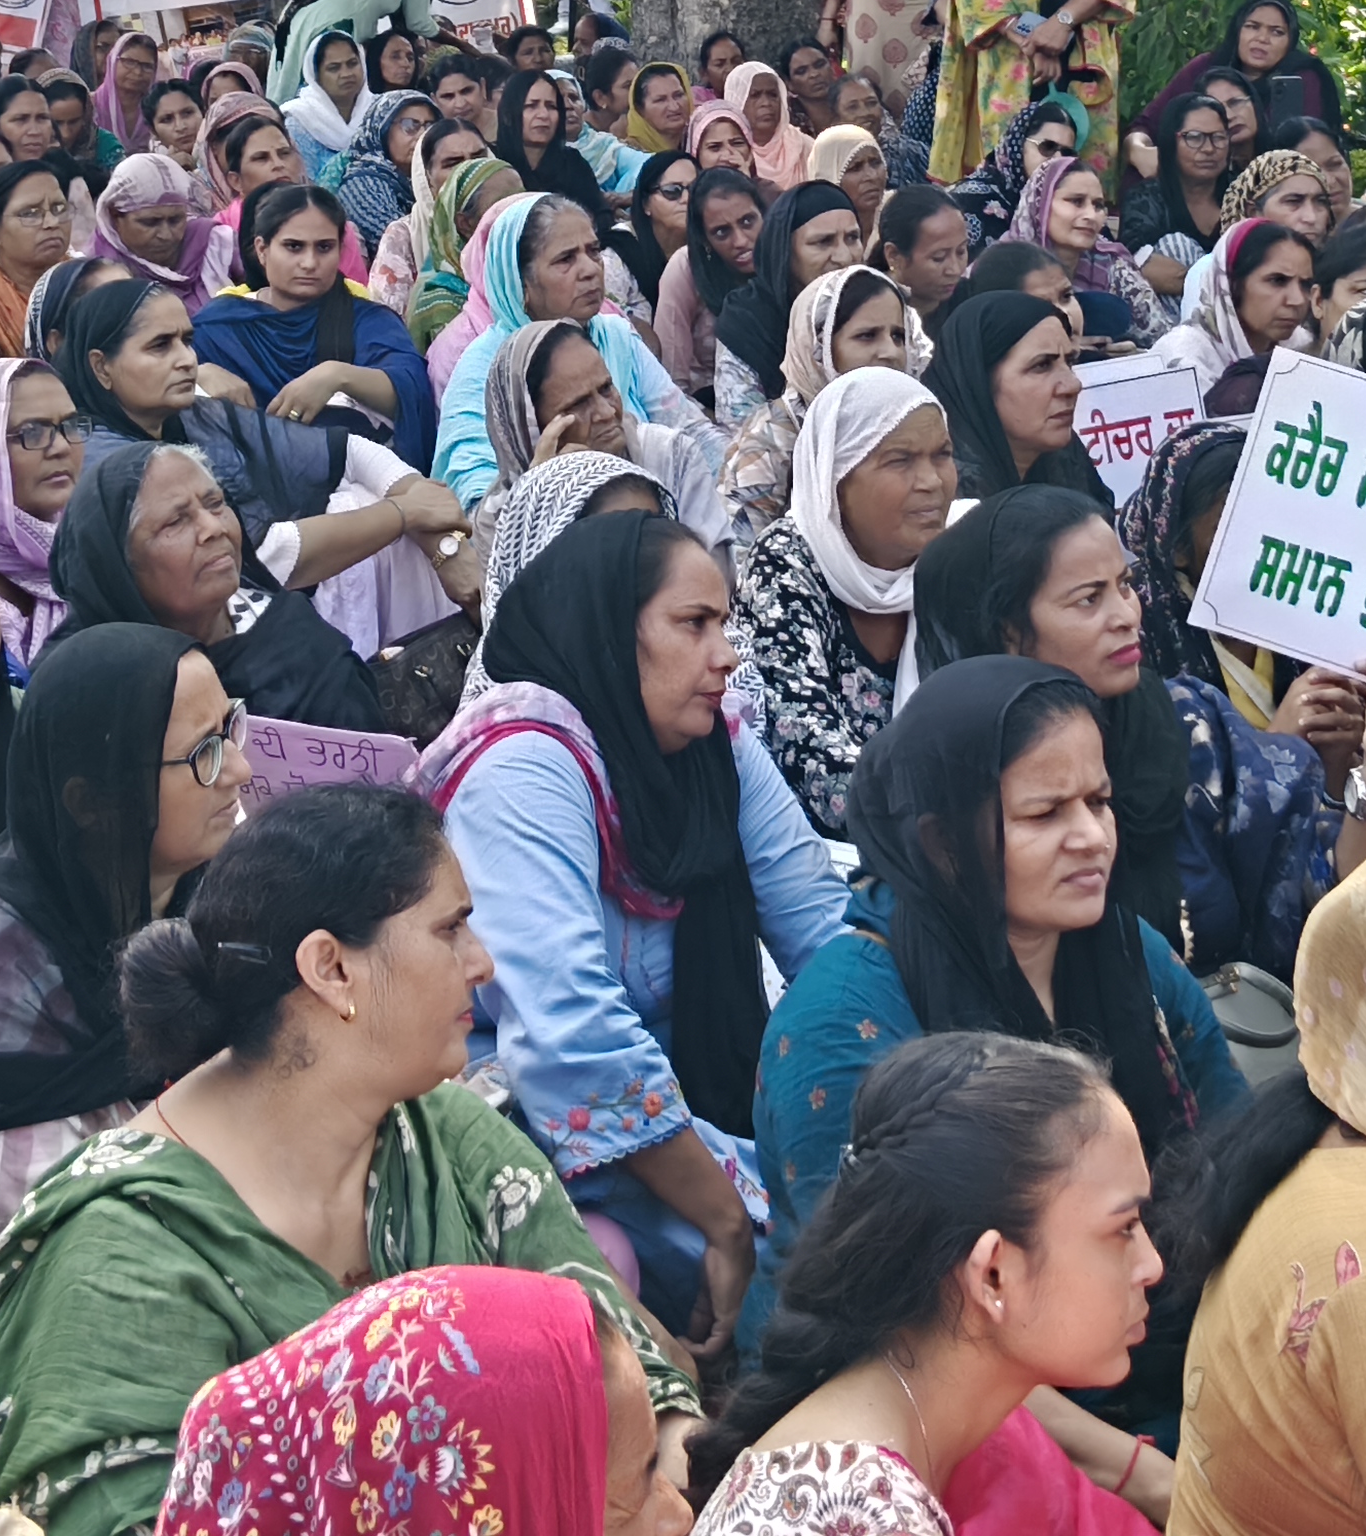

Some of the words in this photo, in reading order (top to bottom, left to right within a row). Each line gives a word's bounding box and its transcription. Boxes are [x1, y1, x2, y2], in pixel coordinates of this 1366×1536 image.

[1079, 408, 1154, 468] ਟੀਚਰ
[1265, 400, 1349, 497] ਕਰੈਚ
[1249, 534, 1352, 617] ਸਮਾਨ
[251, 726, 287, 762] ਦੀ
